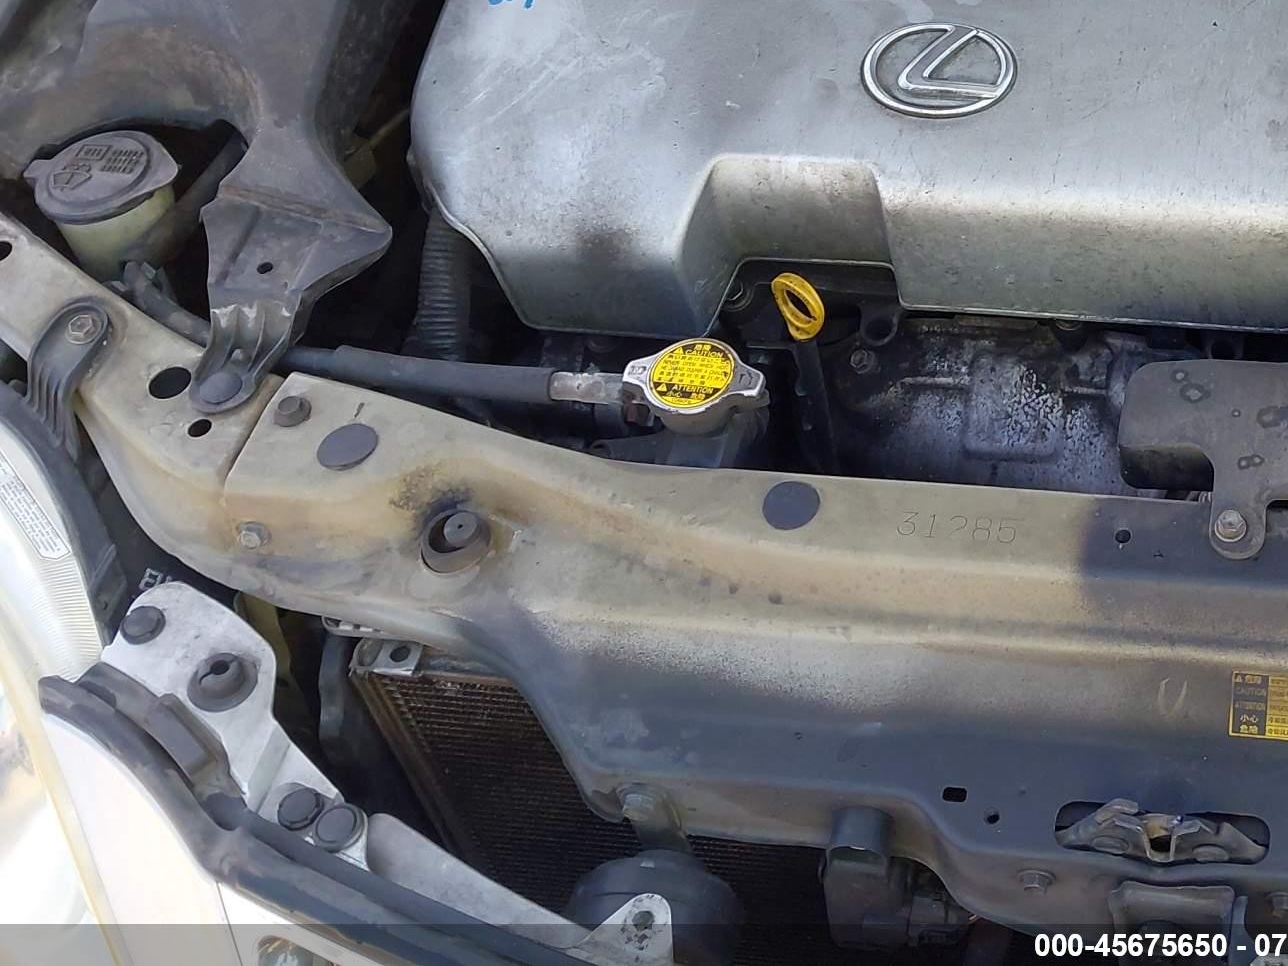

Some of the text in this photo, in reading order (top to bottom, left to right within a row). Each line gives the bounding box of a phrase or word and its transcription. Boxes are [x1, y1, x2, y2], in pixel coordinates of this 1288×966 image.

[685, 349, 724, 359] CAUTION
[671, 384, 714, 394] ATTENTION
[896, 511, 1023, 544] 31285
[1235, 686, 1266, 697] CAUTION
